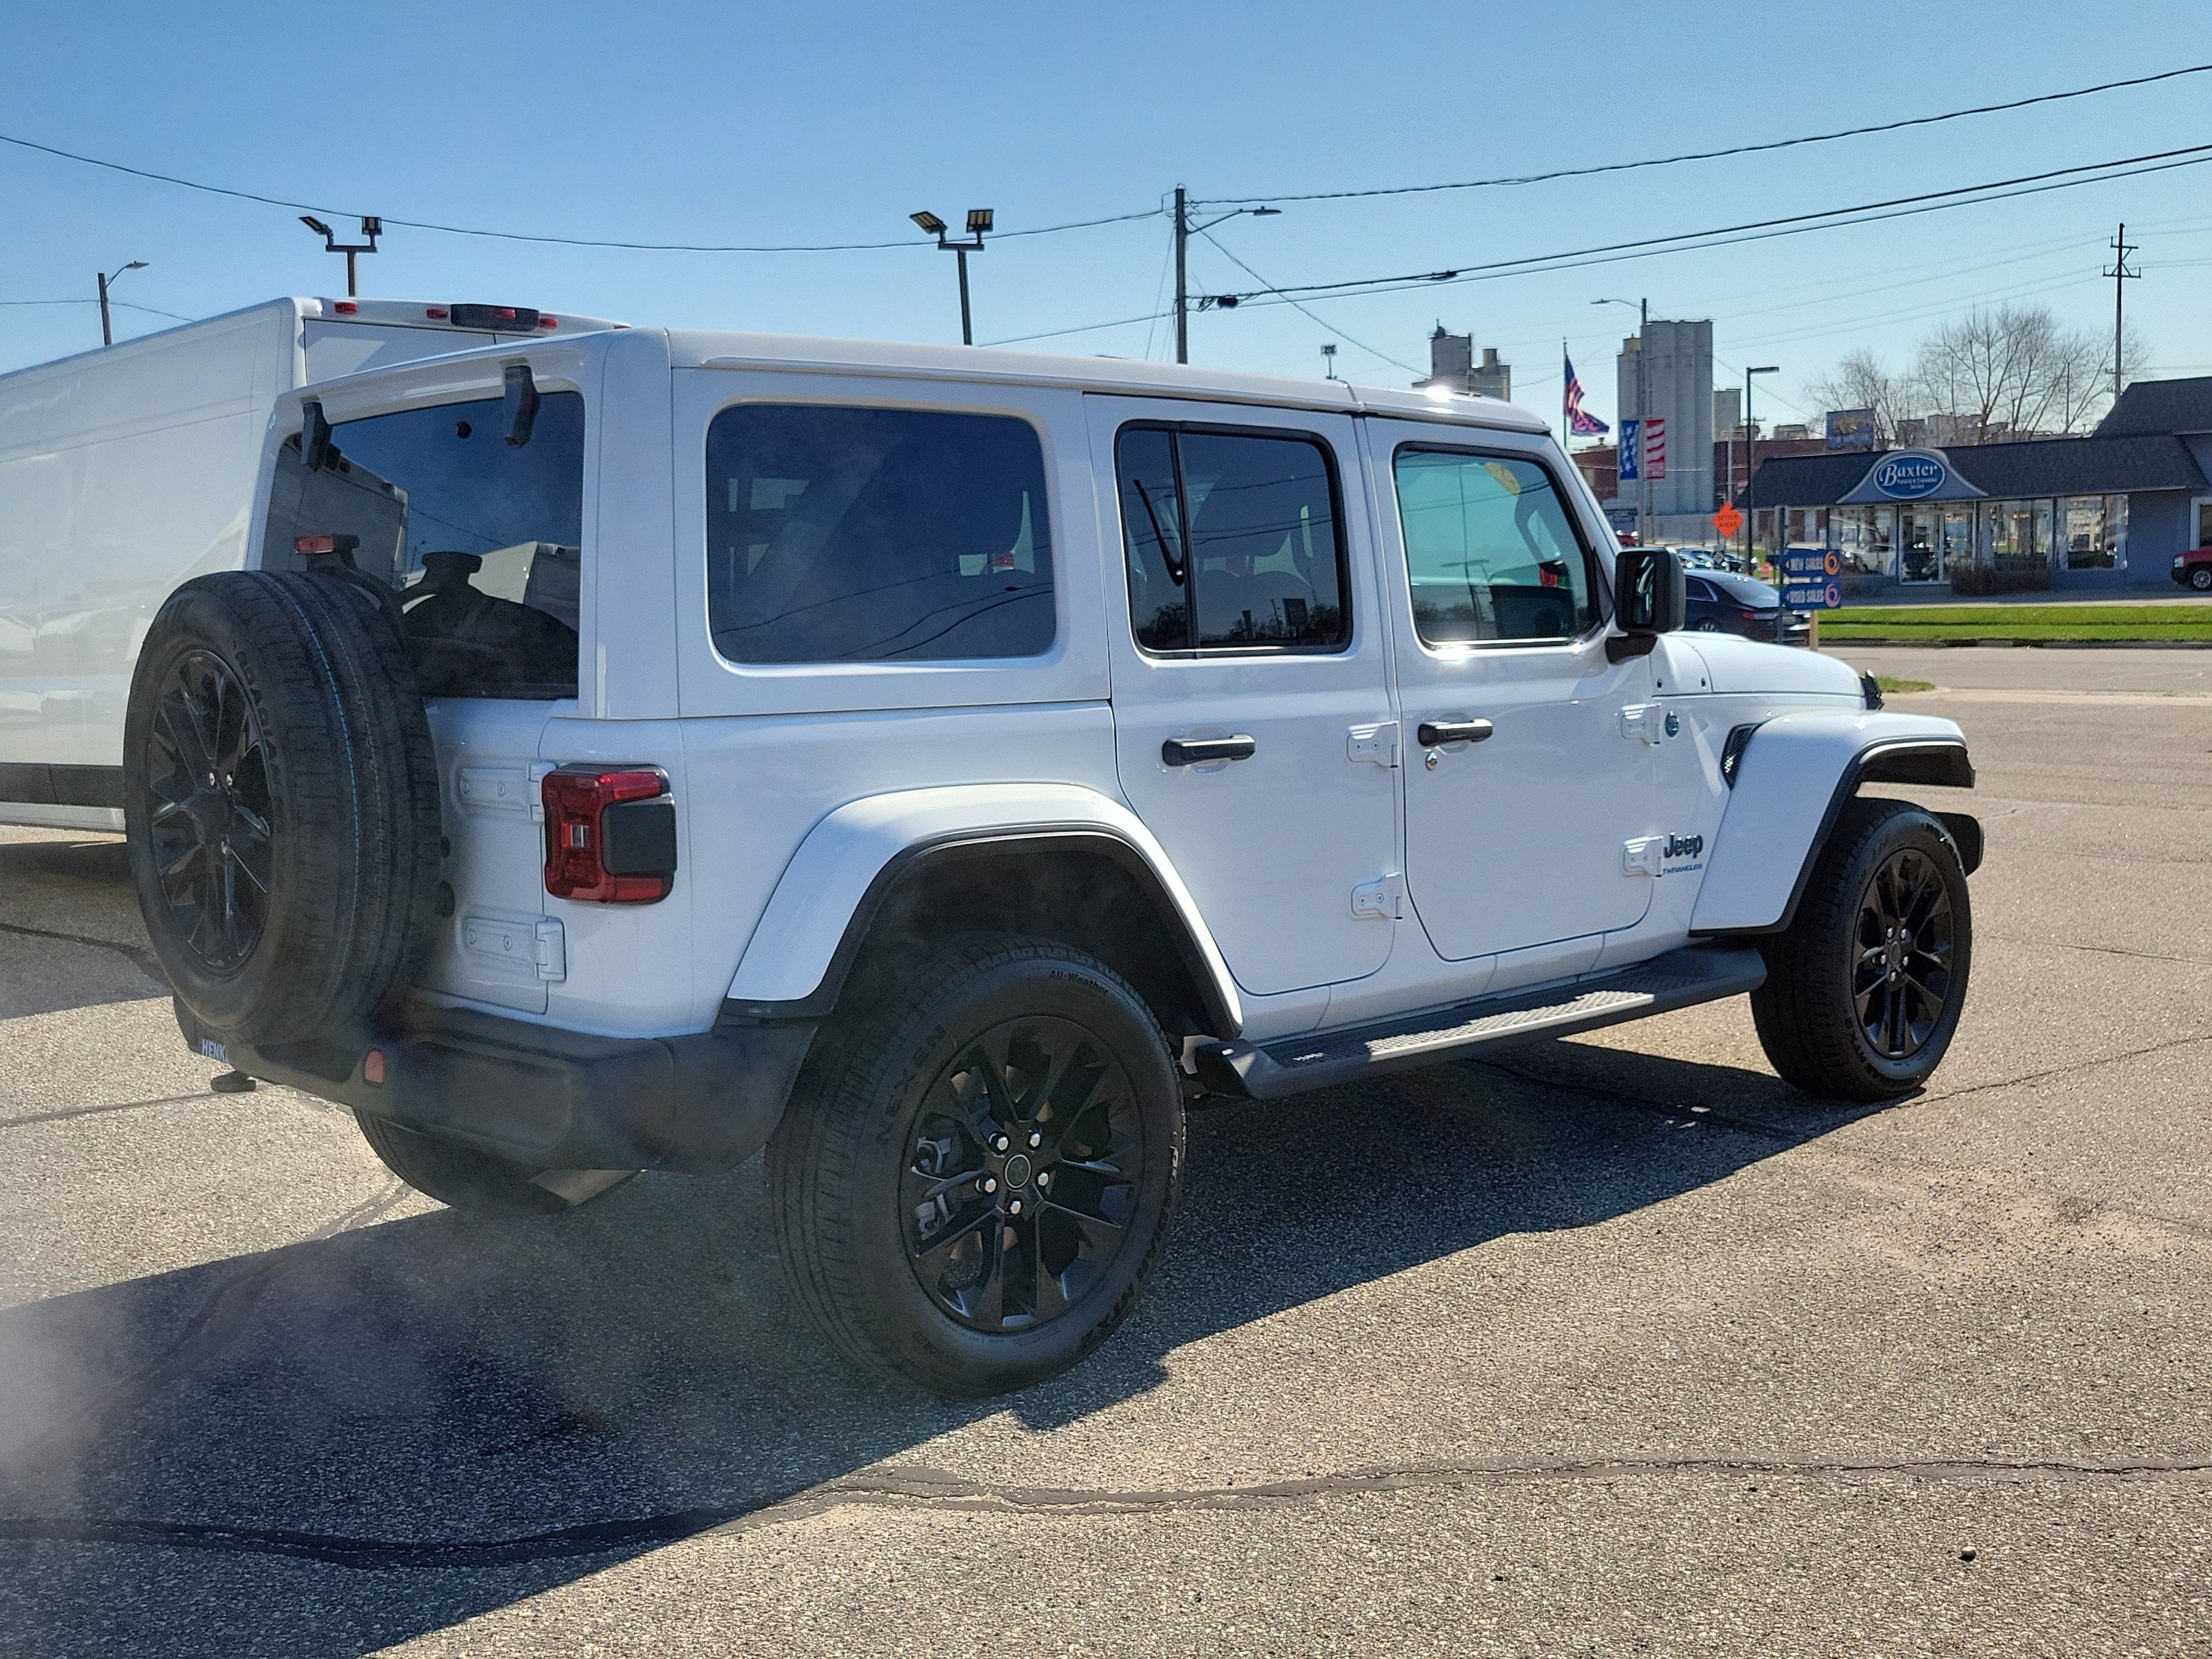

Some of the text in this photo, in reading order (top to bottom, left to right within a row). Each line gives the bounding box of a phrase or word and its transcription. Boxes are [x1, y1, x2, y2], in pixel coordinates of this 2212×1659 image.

[1879, 464, 1938, 487] Baxter
[1805, 557, 1824, 571] SALES
[1790, 589, 1824, 603] USED SALES
[1663, 831, 1703, 859] Jeep
[1048, 969, 1109, 995] All-Weather
[202, 1039, 228, 1063] HENK
